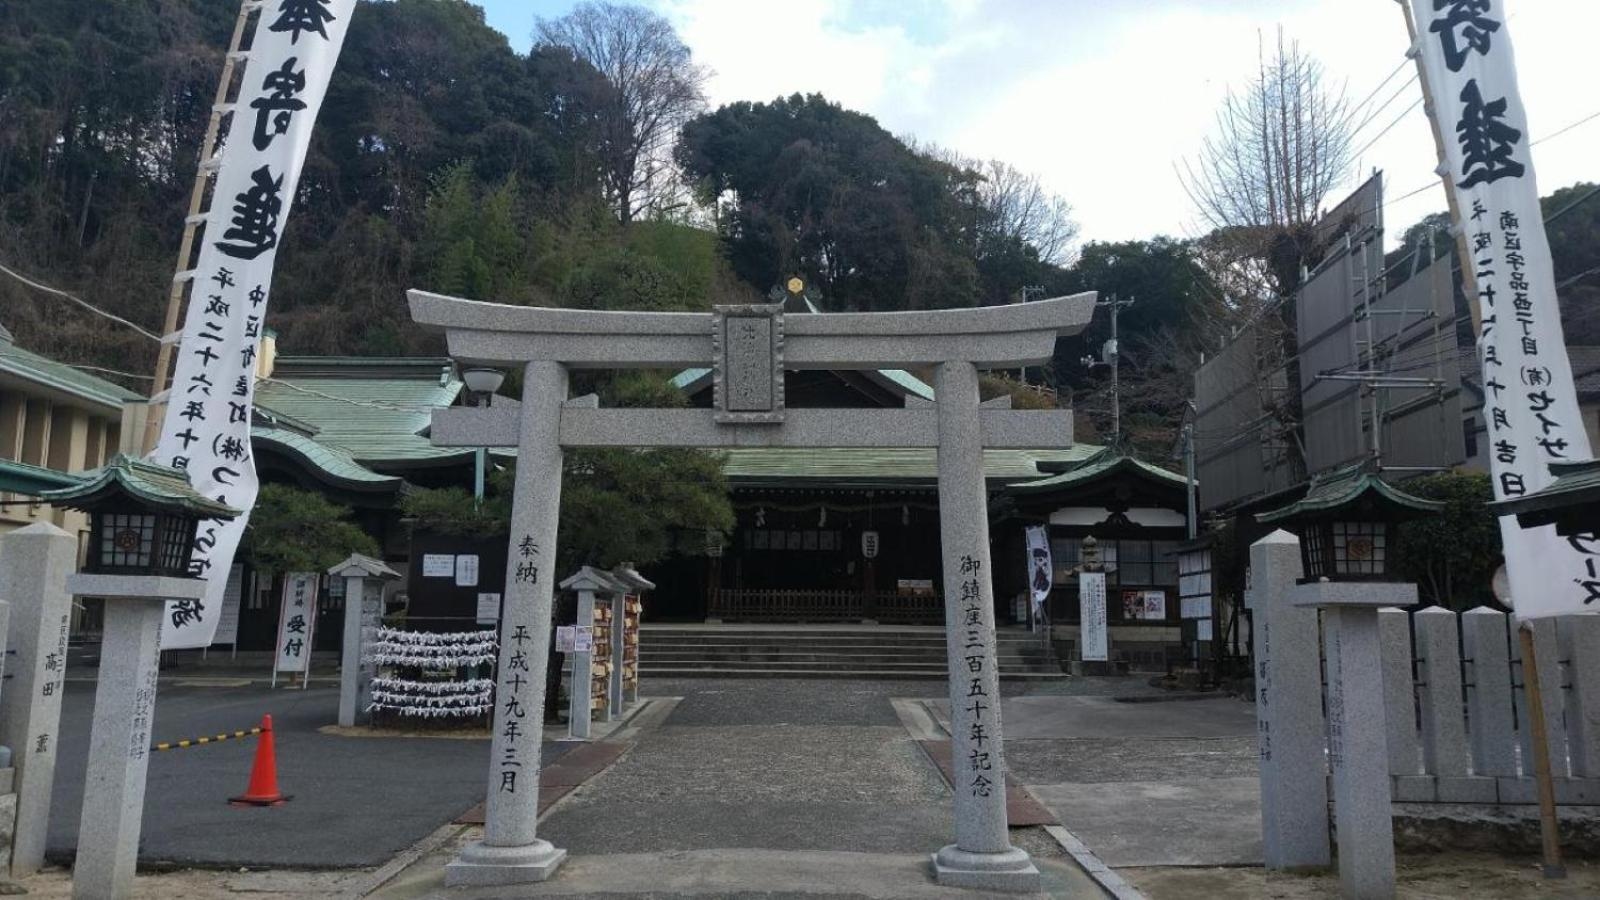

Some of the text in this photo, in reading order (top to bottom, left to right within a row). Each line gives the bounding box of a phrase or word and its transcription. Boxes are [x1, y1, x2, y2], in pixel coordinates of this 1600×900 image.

[284, 614, 306, 658] 受付
[501, 533, 540, 793] 奉納 平成十九年三月
[960, 556, 993, 798] 御鎮座三百五十年記念
